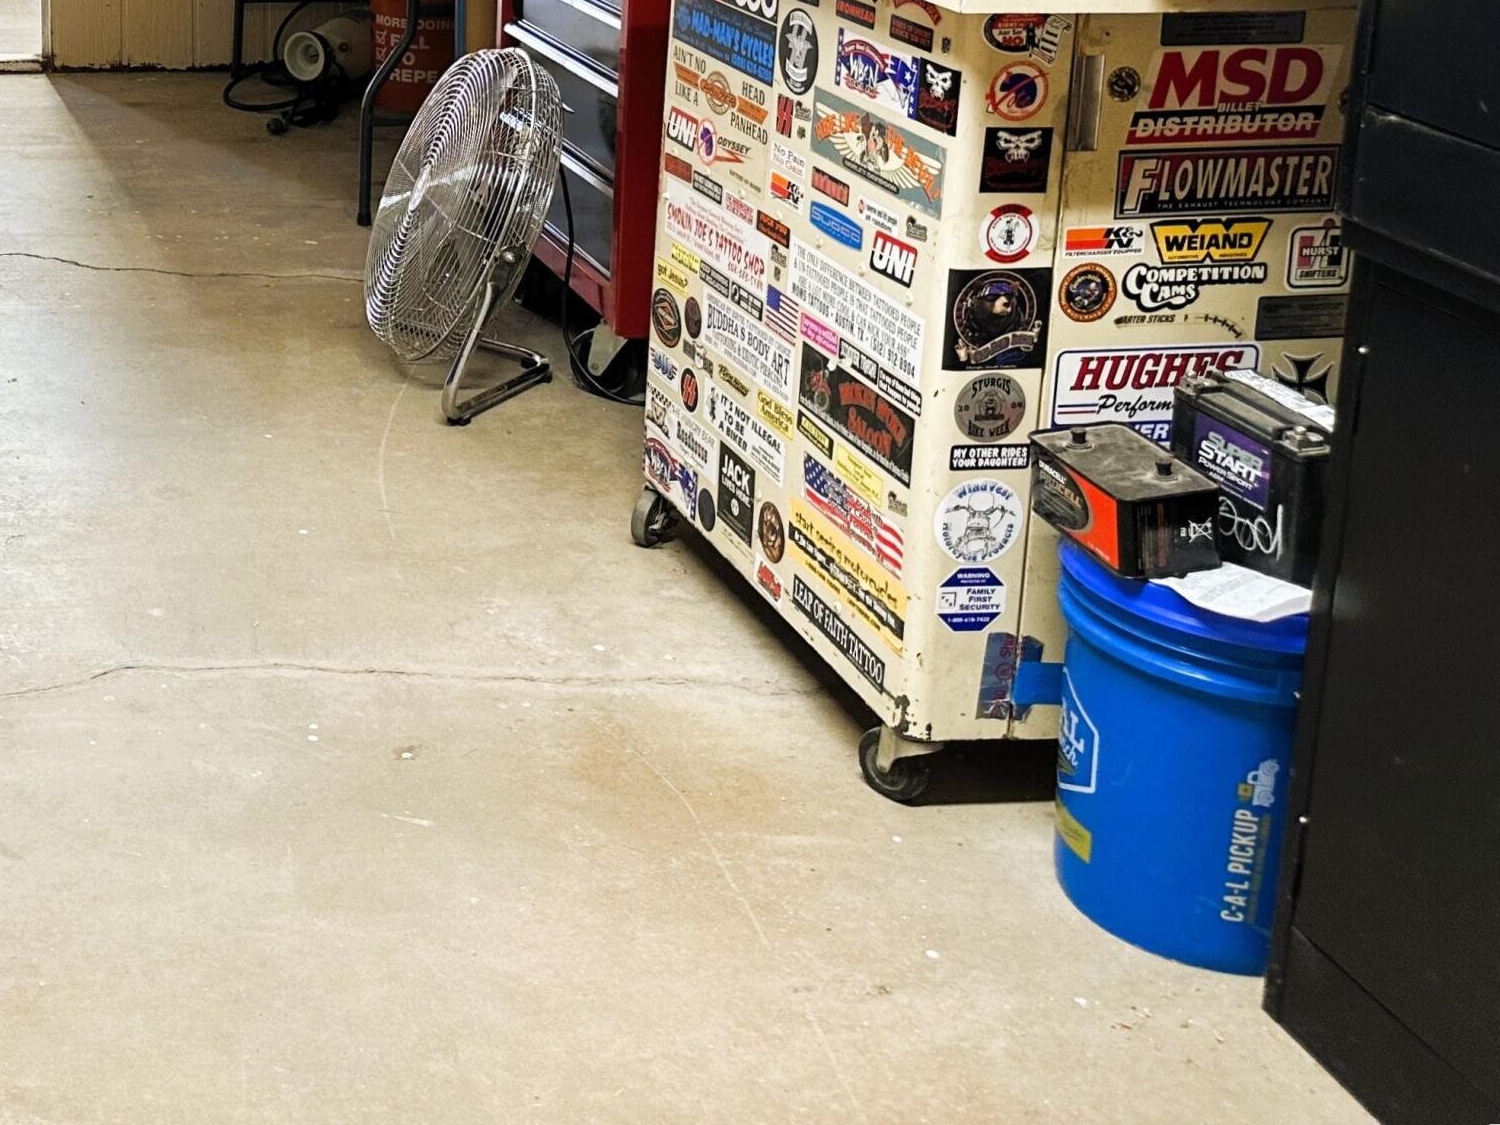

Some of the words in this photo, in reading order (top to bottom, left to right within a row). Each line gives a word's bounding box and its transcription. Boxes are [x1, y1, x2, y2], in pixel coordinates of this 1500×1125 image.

[376, 14, 407, 29] MORE
[836, 0, 874, 23] IRONHEAD
[740, 31, 773, 68] CYCLES
[1002, 36, 1024, 46] NO
[673, 45, 694, 69] AIN'T
[694, 55, 706, 74] NO
[389, 69, 439, 84] REPE
[1148, 47, 1324, 109] MSD
[675, 80, 691, 102] LIKE
[692, 91, 698, 106] A
[741, 81, 765, 106] HEAD
[1216, 102, 1263, 113] BILLET
[668, 109, 697, 150] UNI
[730, 112, 767, 146] PANHEAD
[1134, 112, 1318, 139] DISTRIBUTOR
[717, 136, 751, 155] ODYSSEY
[773, 141, 785, 157] No
[787, 149, 804, 167] Pain
[773, 151, 784, 166] No
[785, 158, 803, 177] Gain
[1122, 155, 1333, 214] FLOWMASTER
[1178, 201, 1218, 209] EXHAUST
[873, 215, 892, 234] random
[1102, 227, 1143, 249] K&N
[1164, 232, 1253, 252] WEIAND
[714, 232, 741, 265] TATTOO
[744, 250, 764, 280] SHOP
[872, 232, 916, 289] UNI
[1302, 246, 1339, 257] HURST
[657, 260, 667, 279] got
[1126, 264, 1265, 295] COMPETITION
[806, 250, 818, 269] ONLY
[819, 259, 847, 287] DIFFERENCE
[848, 277, 872, 304] BETWEEN
[872, 294, 899, 322] TATTOOED
[1140, 283, 1196, 308] CAMS
[707, 303, 745, 354] BUDDHA'S
[747, 331, 770, 361] BODY
[771, 349, 790, 387] ART
[1070, 349, 1245, 392] HUGHES
[971, 377, 1011, 398] STURGIS
[757, 389, 772, 412] God
[774, 401, 792, 426] Bless
[761, 403, 789, 434] America
[958, 404, 969, 412] 20
[1097, 393, 1174, 418] Perform
[718, 420, 724, 432] A
[725, 425, 747, 452] BIKER
[720, 393, 732, 412] IT'S
[734, 405, 749, 426] NOT
[751, 420, 781, 455] ILLEGAL
[724, 410, 733, 427] TO
[735, 420, 744, 436] BE
[968, 419, 984, 437] BIKE
[989, 418, 1010, 436] WEEK
[952, 458, 976, 468] YOUR
[978, 457, 1027, 467] DAUGHTER!
[953, 448, 967, 458] MY
[969, 448, 999, 458] OTHER
[1001, 447, 1028, 458] RIDES
[1198, 440, 1262, 483] START
[1208, 431, 1263, 472] SUPER
[721, 476, 736, 494] LIVES
[722, 454, 750, 494] JACK
[795, 511, 814, 533] start
[843, 555, 898, 608] motorcycles
[966, 588, 996, 596] FAMILY
[968, 595, 992, 603] FIRST
[959, 603, 1001, 611] SECURITY
[794, 577, 812, 613] LEAP
[812, 596, 823, 625] OF
[823, 608, 847, 649] FAITH
[847, 633, 882, 687] TATTOO
[1227, 809, 1260, 875] PICKUP
